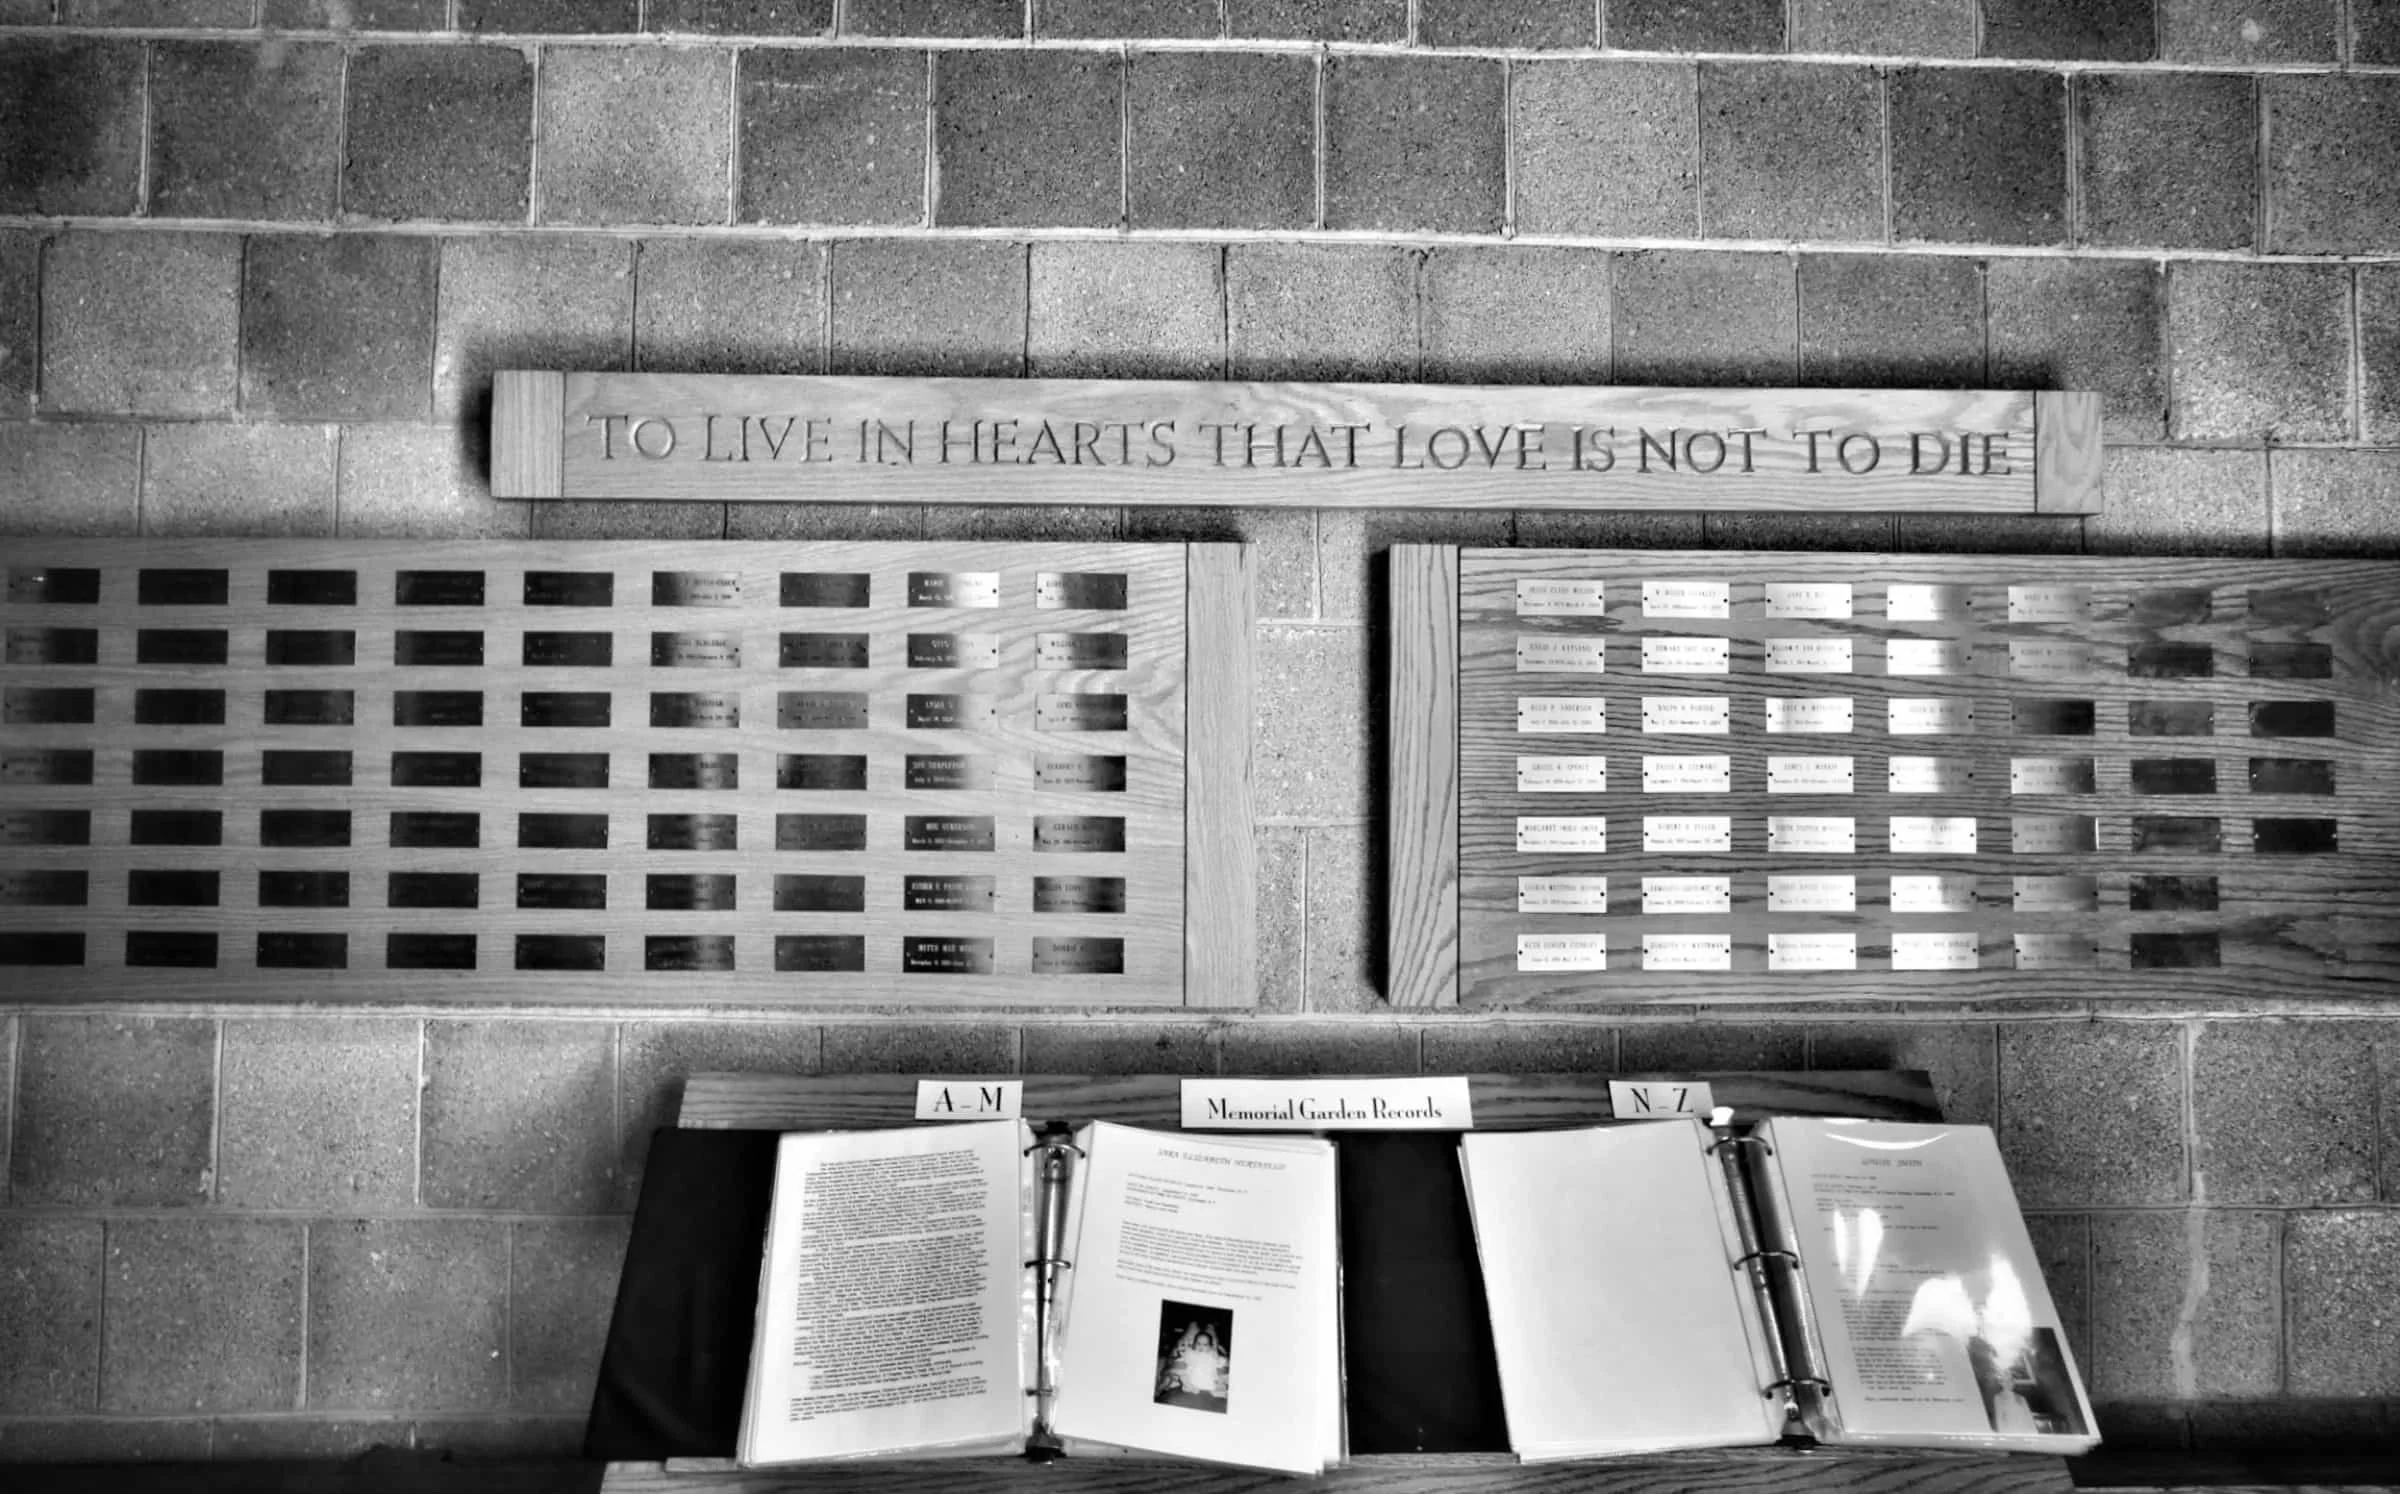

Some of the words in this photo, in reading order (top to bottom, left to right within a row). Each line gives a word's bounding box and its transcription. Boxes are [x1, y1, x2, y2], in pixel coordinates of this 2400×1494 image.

[584, 415, 676, 460] TO
[704, 415, 833, 463] LIVE
[857, 418, 913, 466] IN
[940, 418, 1177, 468] HEARTS
[1199, 423, 1371, 468] THAT
[1396, 422, 1548, 471] LOVE
[1570, 425, 1616, 472] IS
[1636, 426, 1768, 475] NOT
[1792, 429, 1880, 475] TO
[1909, 431, 2012, 476] DIE
[1207, 1097, 1294, 1120] Memorial
[1298, 1097, 1366, 1120] Garden
[1372, 1096, 1443, 1119] Records
